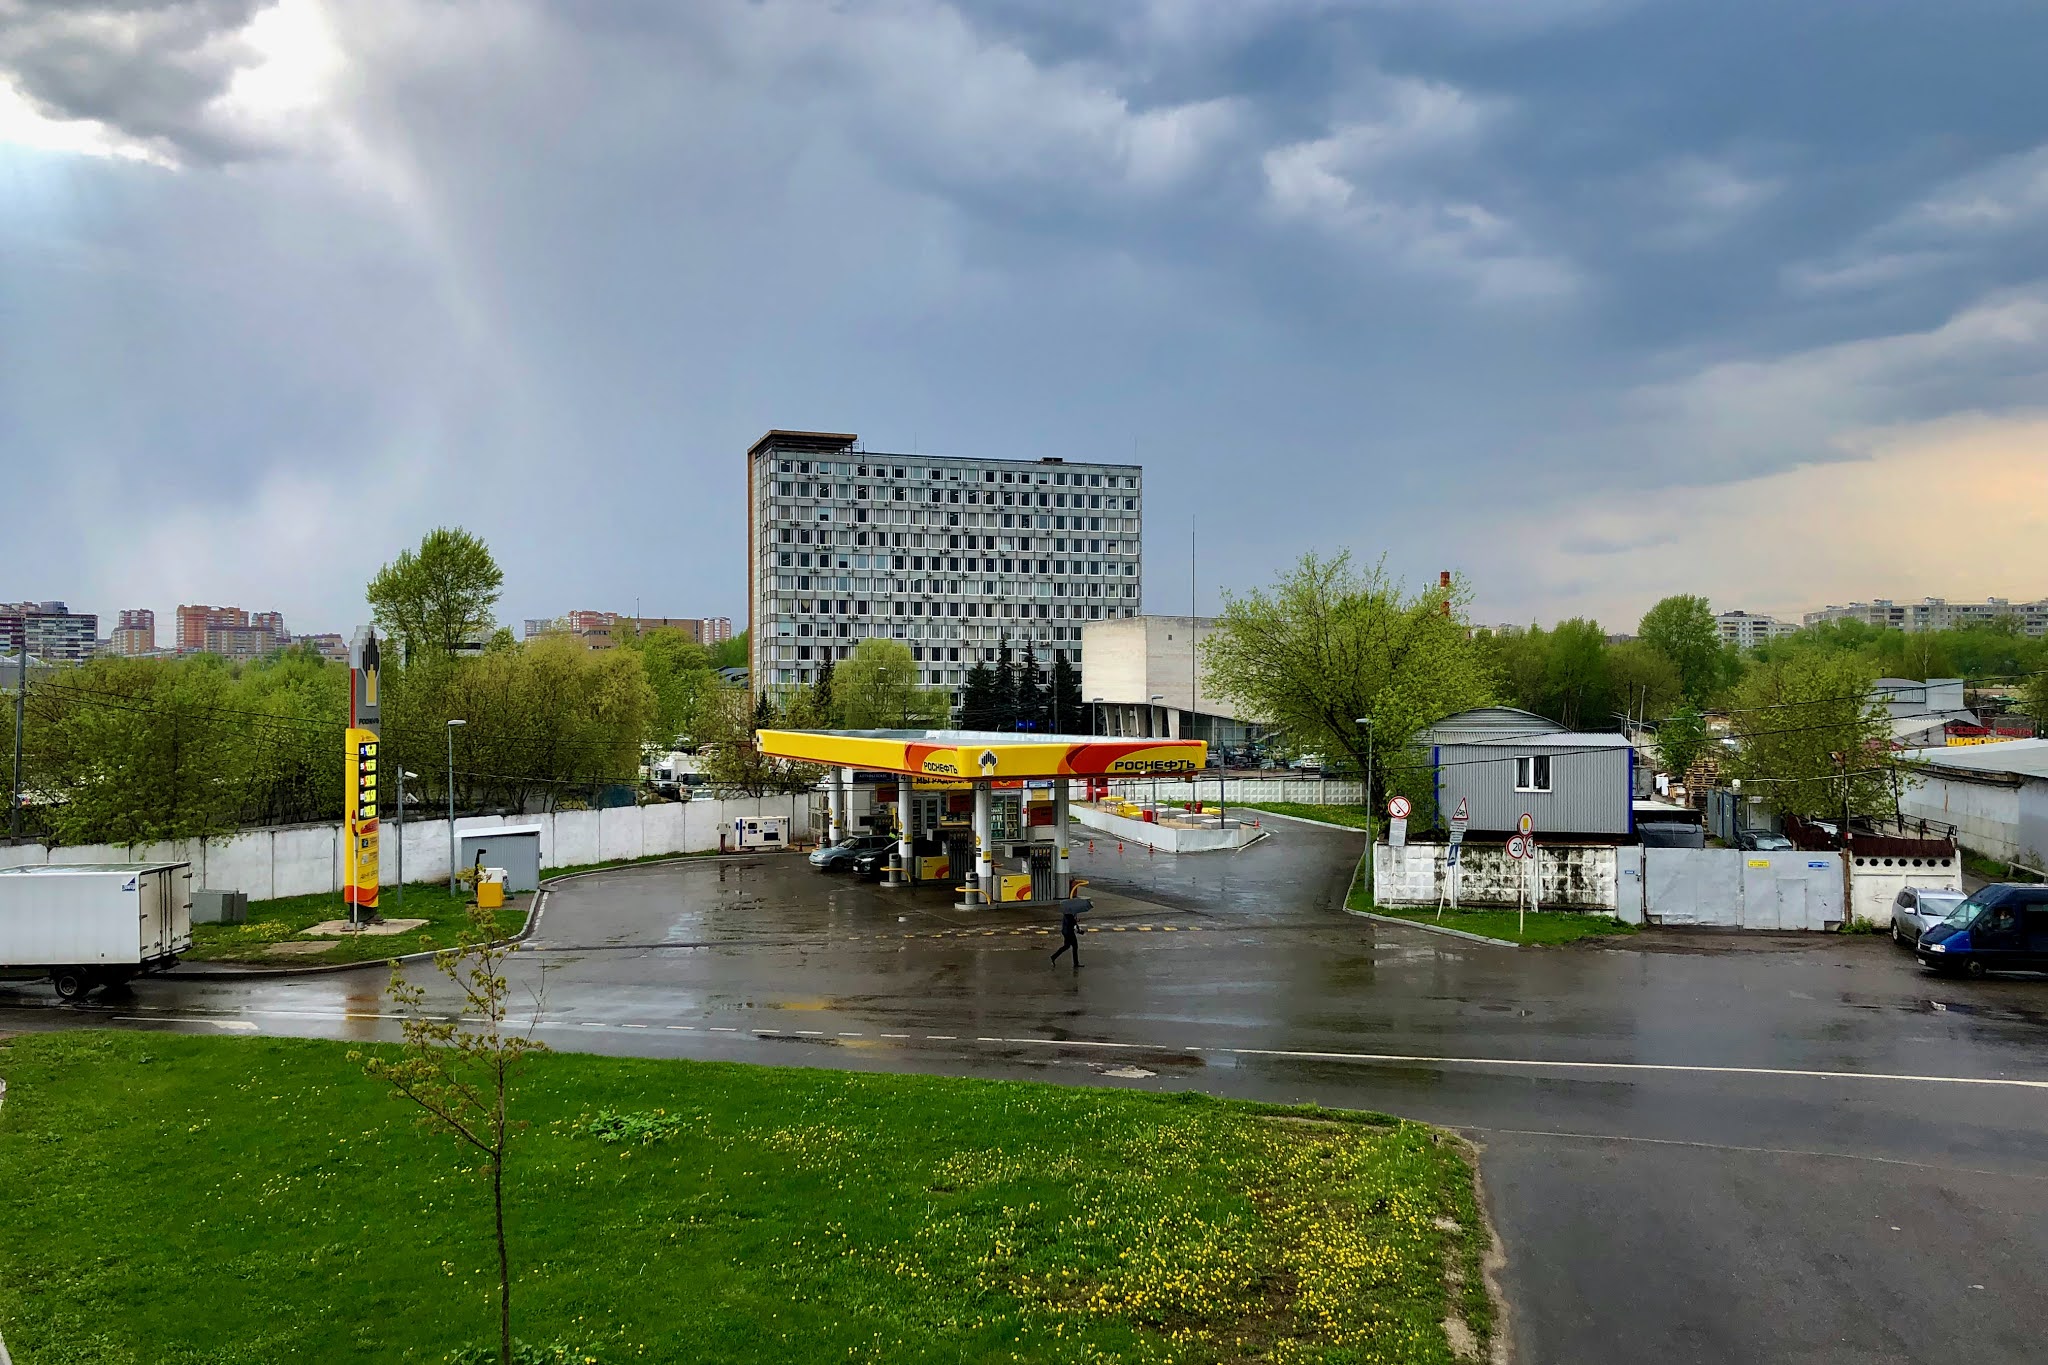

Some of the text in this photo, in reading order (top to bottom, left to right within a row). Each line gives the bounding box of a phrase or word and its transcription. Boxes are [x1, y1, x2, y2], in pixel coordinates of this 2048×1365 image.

[923, 761, 958, 774] РОСНЕФТЬ
[1114, 760, 1196, 770] РОСНЕФТЬ
[900, 774, 907, 782] 4
[979, 782, 985, 791] 6
[1512, 842, 1523, 852] 20
